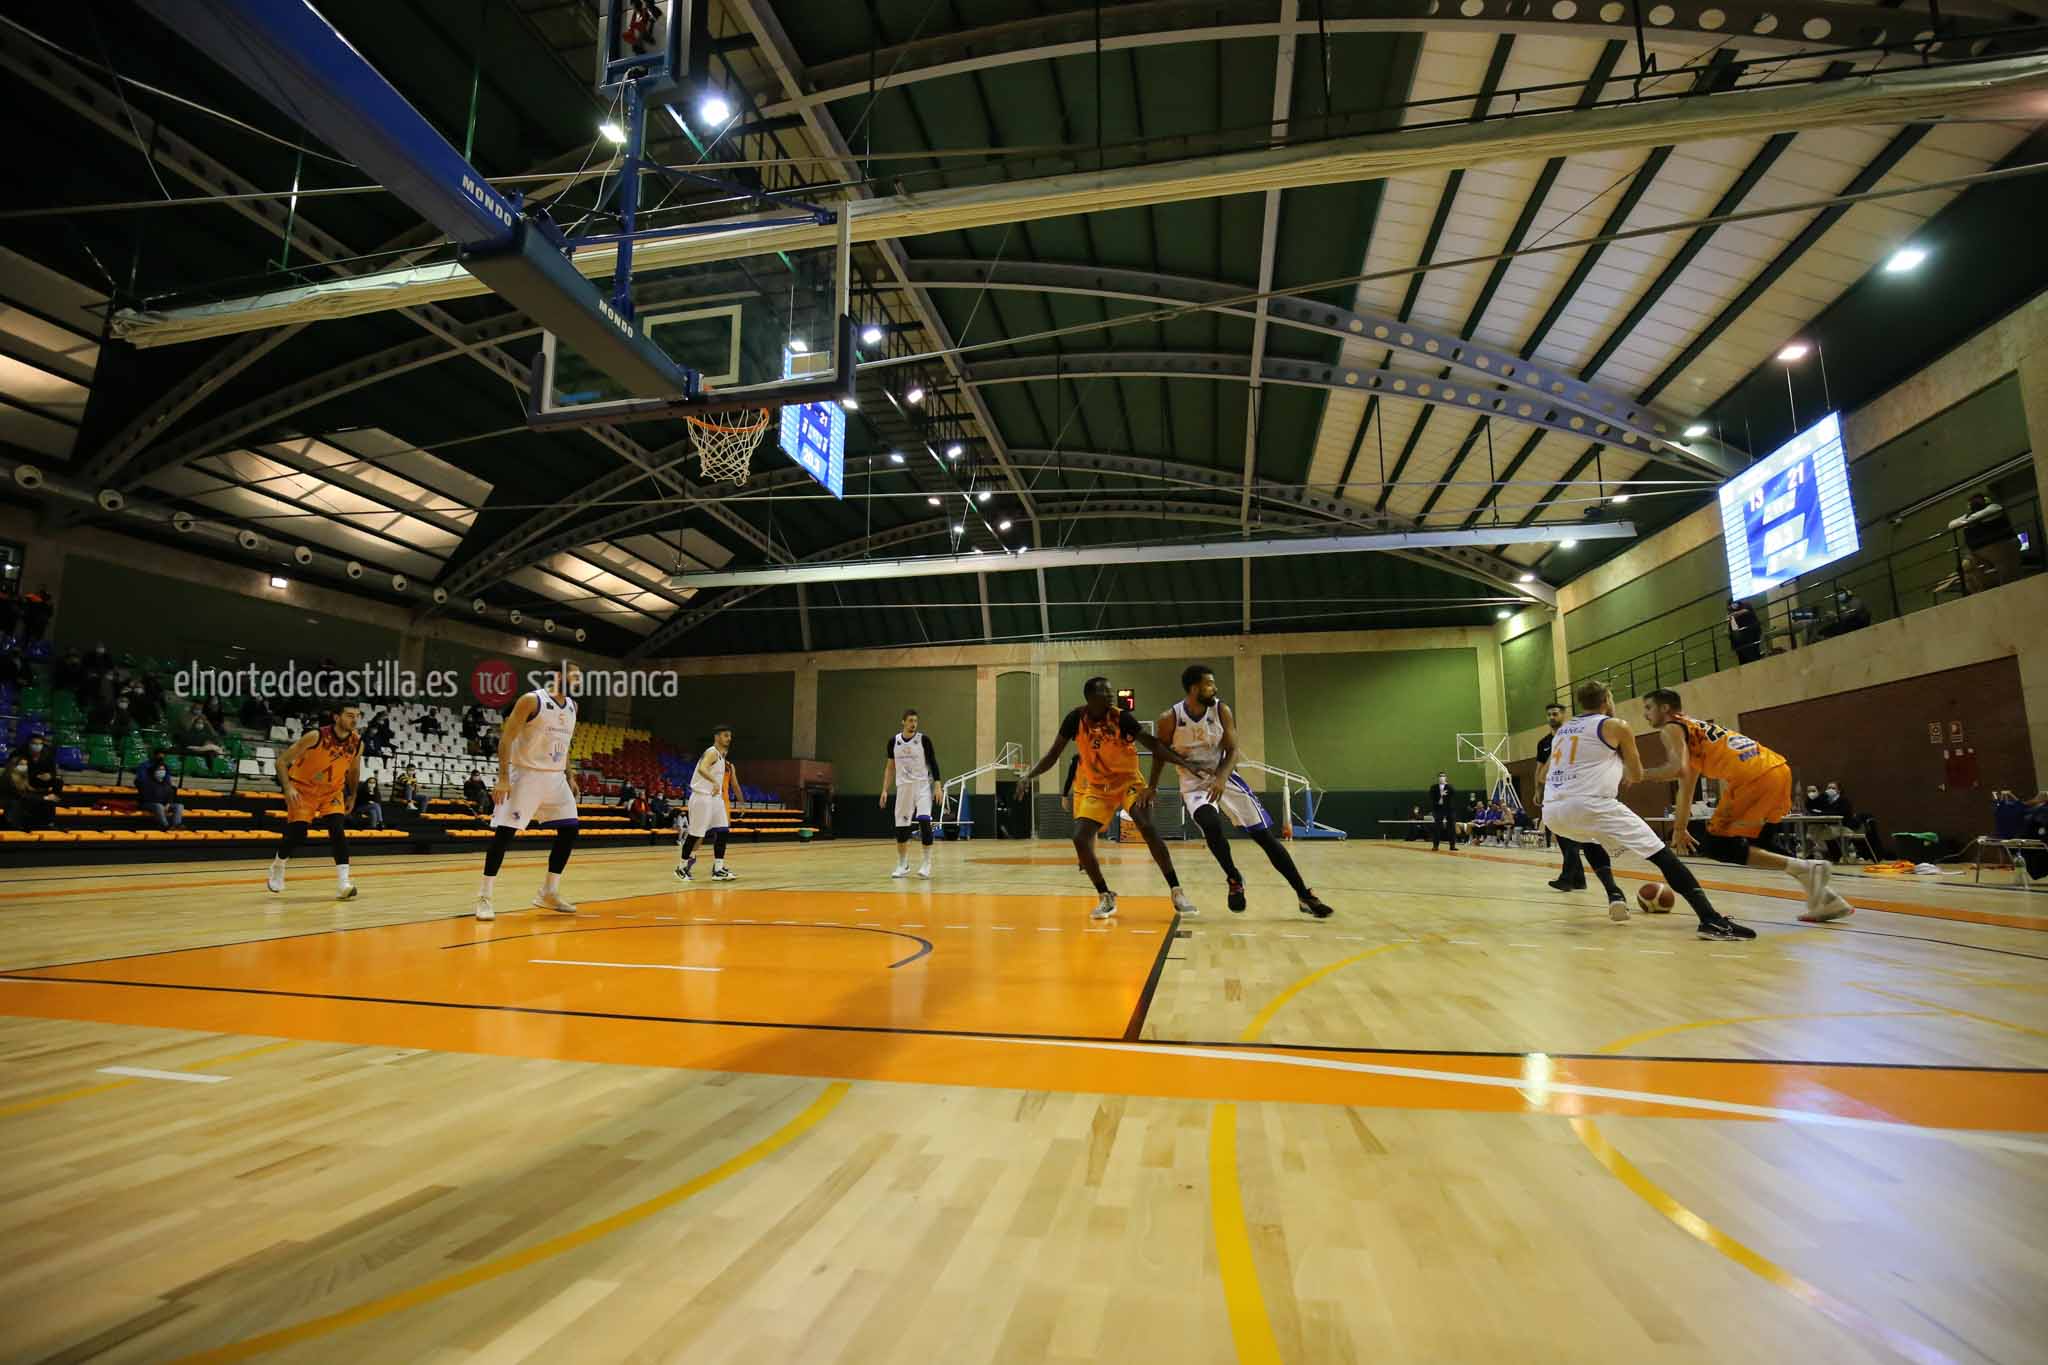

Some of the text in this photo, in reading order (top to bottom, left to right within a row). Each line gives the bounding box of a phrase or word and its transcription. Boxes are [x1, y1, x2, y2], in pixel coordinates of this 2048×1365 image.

[462, 174, 513, 227] MONDO
[599, 299, 635, 339] MONDO
[1787, 461, 1806, 493] 21
[1126, 698, 1134, 709] 7
[1552, 735, 1579, 767] 41
